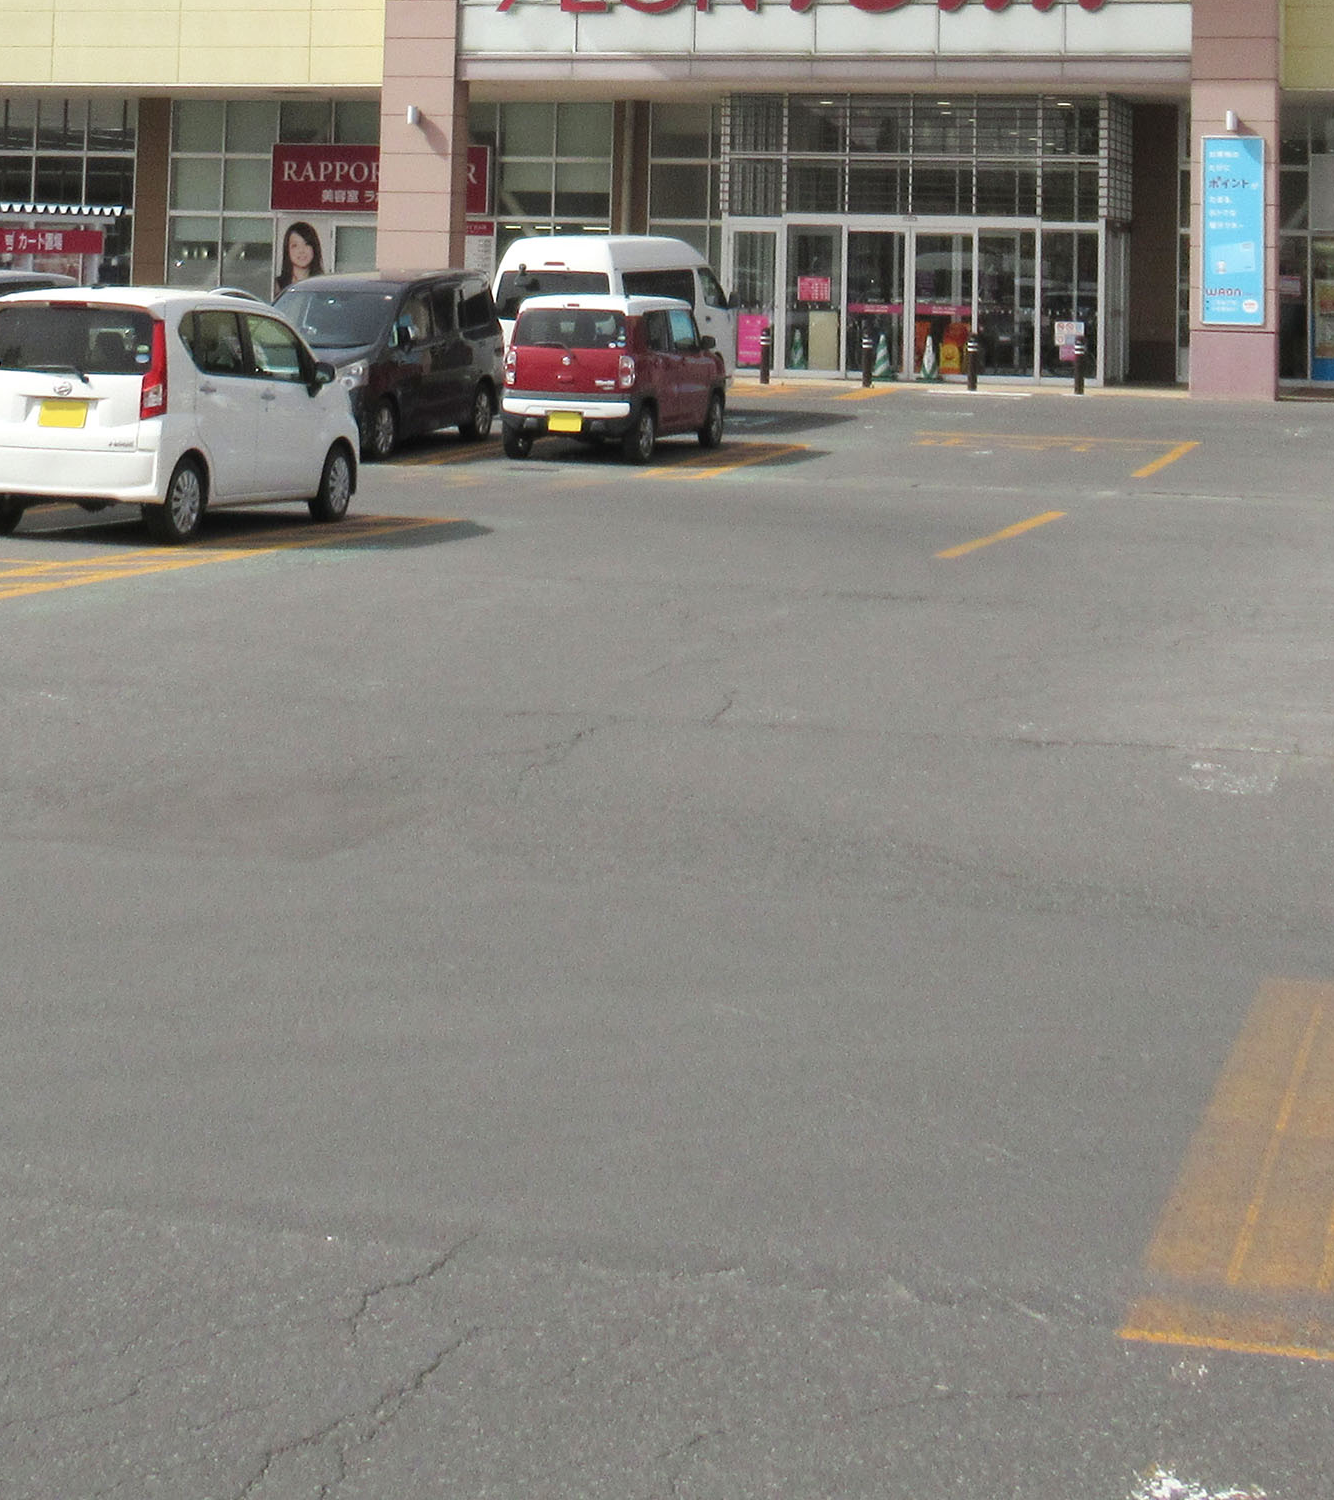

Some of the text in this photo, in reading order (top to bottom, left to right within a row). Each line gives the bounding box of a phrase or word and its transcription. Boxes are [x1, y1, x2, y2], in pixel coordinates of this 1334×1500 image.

[282, 160, 380, 184] RAPPOR
[1208, 176, 1250, 189] ポイント
[18, 233, 63, 251] カート置場
